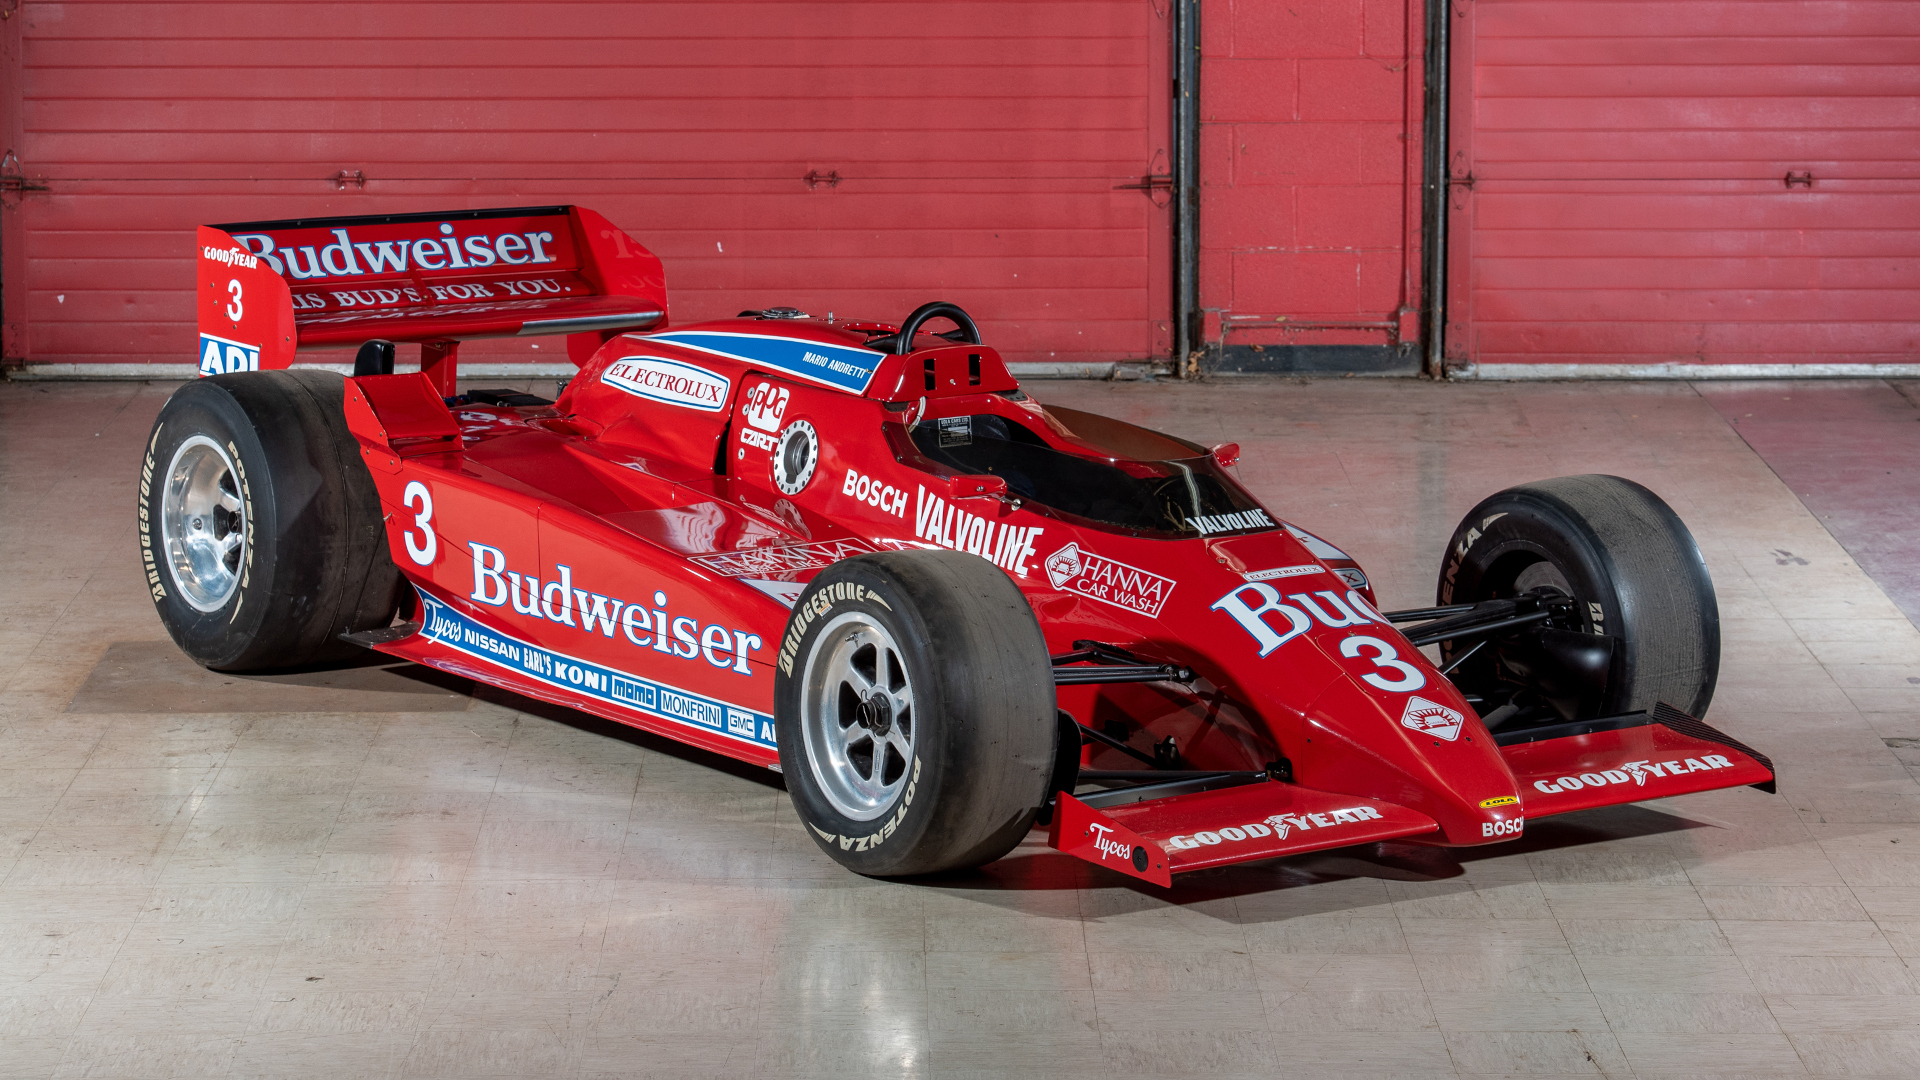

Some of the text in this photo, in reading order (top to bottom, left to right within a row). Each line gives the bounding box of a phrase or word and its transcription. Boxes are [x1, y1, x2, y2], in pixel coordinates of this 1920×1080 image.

[232, 223, 553, 278] Budweiser
[227, 279, 243, 322] 3
[329, 288, 421, 307] BUD'S
[427, 281, 495, 301] FOR
[498, 278, 571, 299] YOU.
[608, 363, 722, 403] ELECTROLUX
[802, 351, 866, 379] MARIO ANDRETTI
[740, 428, 779, 451] CART
[228, 440, 254, 589] POTENZA
[842, 468, 908, 518] BOSCH
[138, 451, 168, 603] BRIDGESTONE
[403, 481, 437, 566] 3
[914, 483, 1044, 577] VALVOLINE
[1185, 508, 1275, 535] VALVOLINE
[1077, 578, 1159, 614] CAR WASH
[1080, 556, 1163, 602] HANNA
[1249, 566, 1319, 580] ELECTROLUX
[467, 541, 763, 677] Budweiser
[777, 581, 866, 679] BRIDGESTONE
[425, 598, 461, 645] Tycos
[464, 628, 520, 662] NISSAN
[523, 647, 551, 677] EARL'S
[554, 661, 608, 692] KONI
[662, 692, 721, 725] MONFRINI
[730, 713, 754, 733] GMC
[1339, 635, 1426, 693] 3
[839, 754, 922, 852] POTENZA
[1485, 797, 1515, 806] LOLA
[1090, 822, 1131, 860] Tycos
